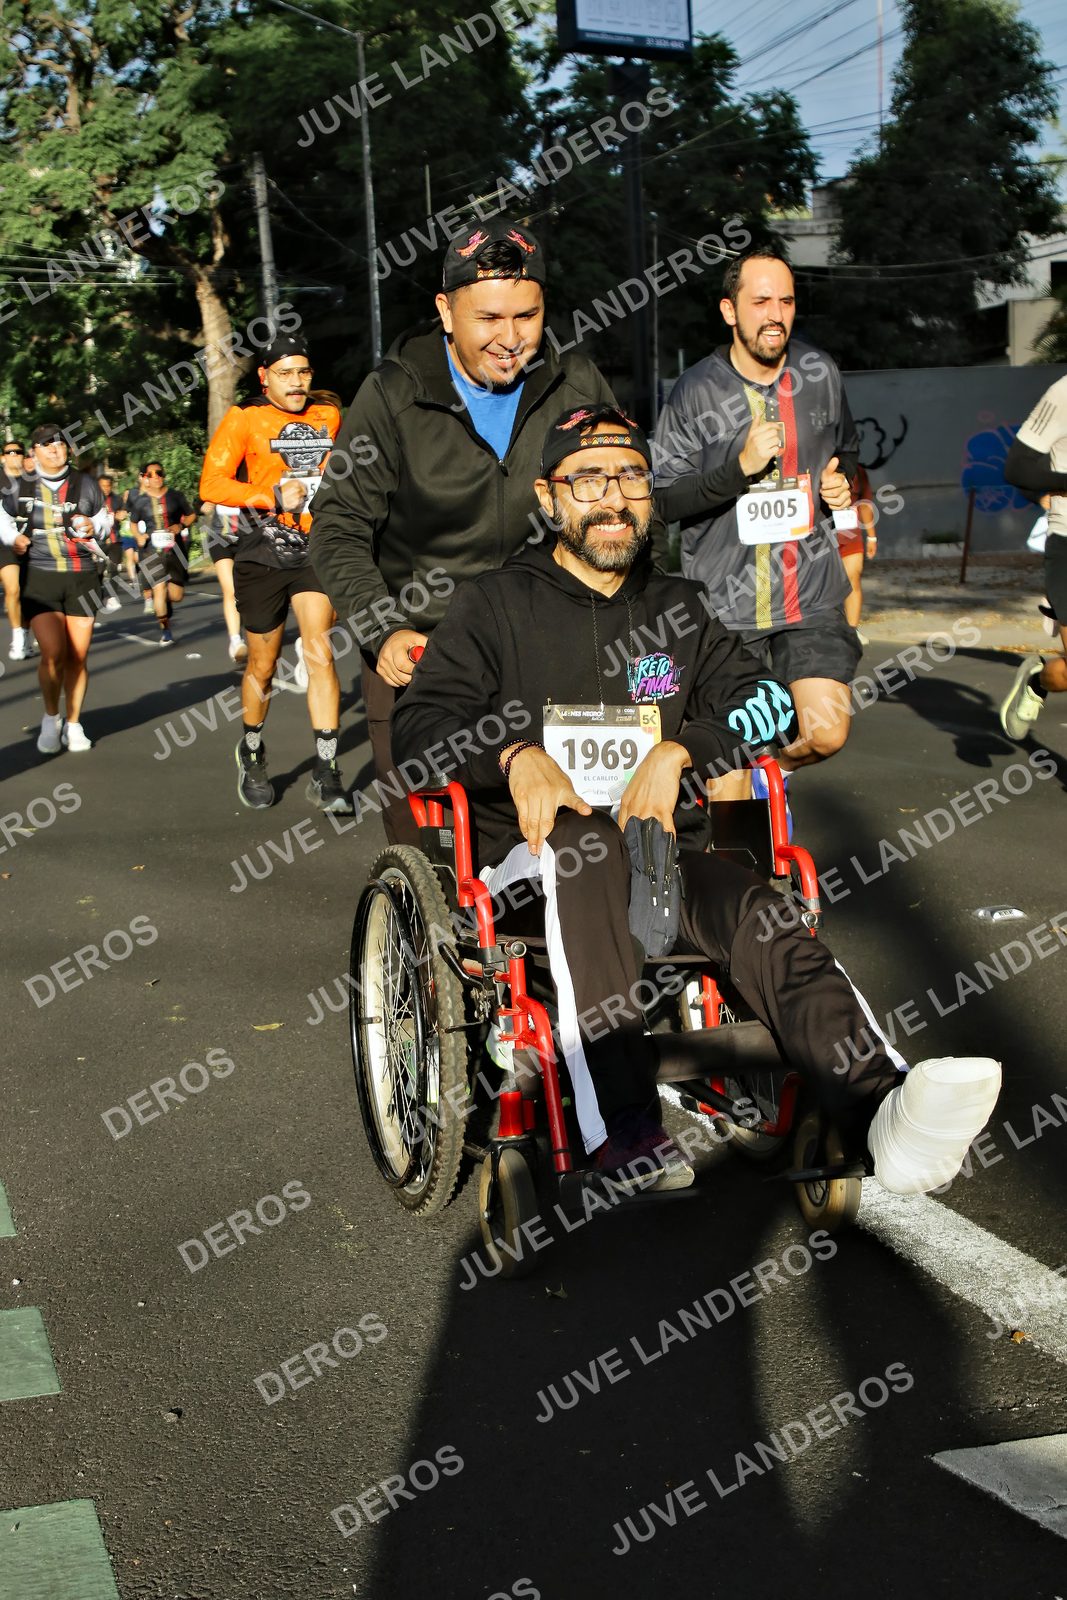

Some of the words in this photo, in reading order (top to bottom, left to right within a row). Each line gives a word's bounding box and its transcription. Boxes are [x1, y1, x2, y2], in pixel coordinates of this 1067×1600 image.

[747, 499, 797, 521] 9005
[637, 657, 670, 681] RETO
[637, 672, 674, 696] FINAL
[642, 715, 657, 725] 5K
[728, 680, 794, 745] 202
[562, 738, 638, 770] 1969
